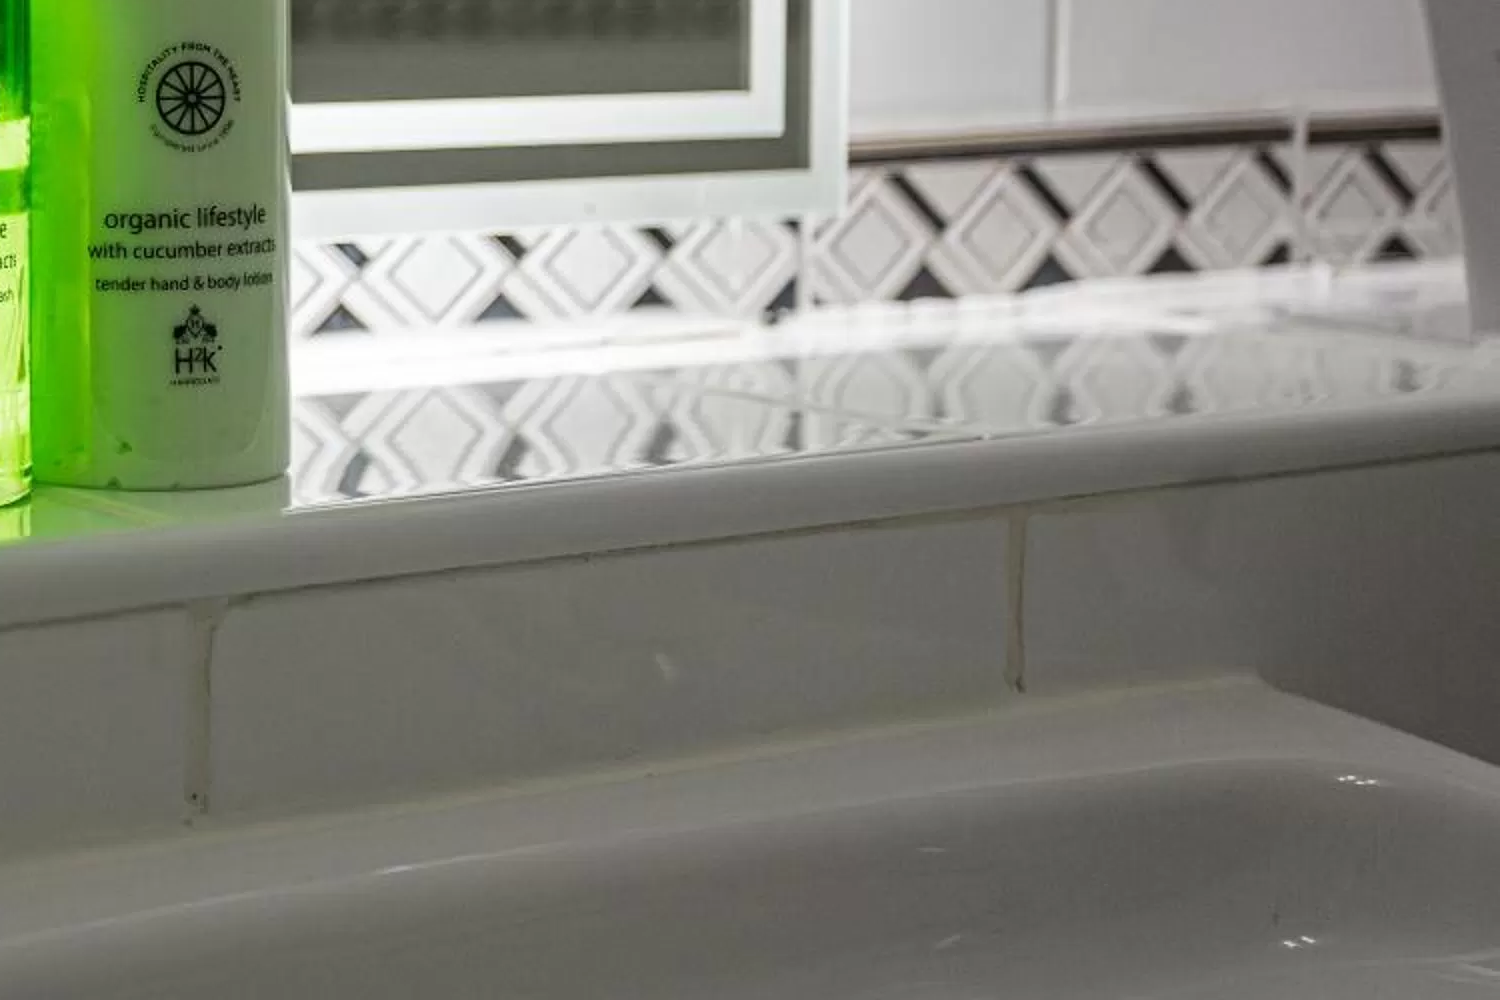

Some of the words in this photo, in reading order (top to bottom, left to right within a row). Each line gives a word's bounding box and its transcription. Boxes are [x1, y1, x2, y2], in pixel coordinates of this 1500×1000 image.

[136, 45, 178, 103] HOSPITALITY
[180, 40, 212, 53] FROM
[104, 209, 191, 235] organic
[197, 204, 267, 230] lifestyle
[87, 241, 127, 259] with
[133, 240, 222, 260] cucumber
[226, 236, 276, 256] extracts
[95, 275, 146, 292] tender
[151, 275, 189, 291] hand
[193, 275, 205, 291] &
[207, 273, 241, 292] body
[243, 271, 273, 287] lotion
